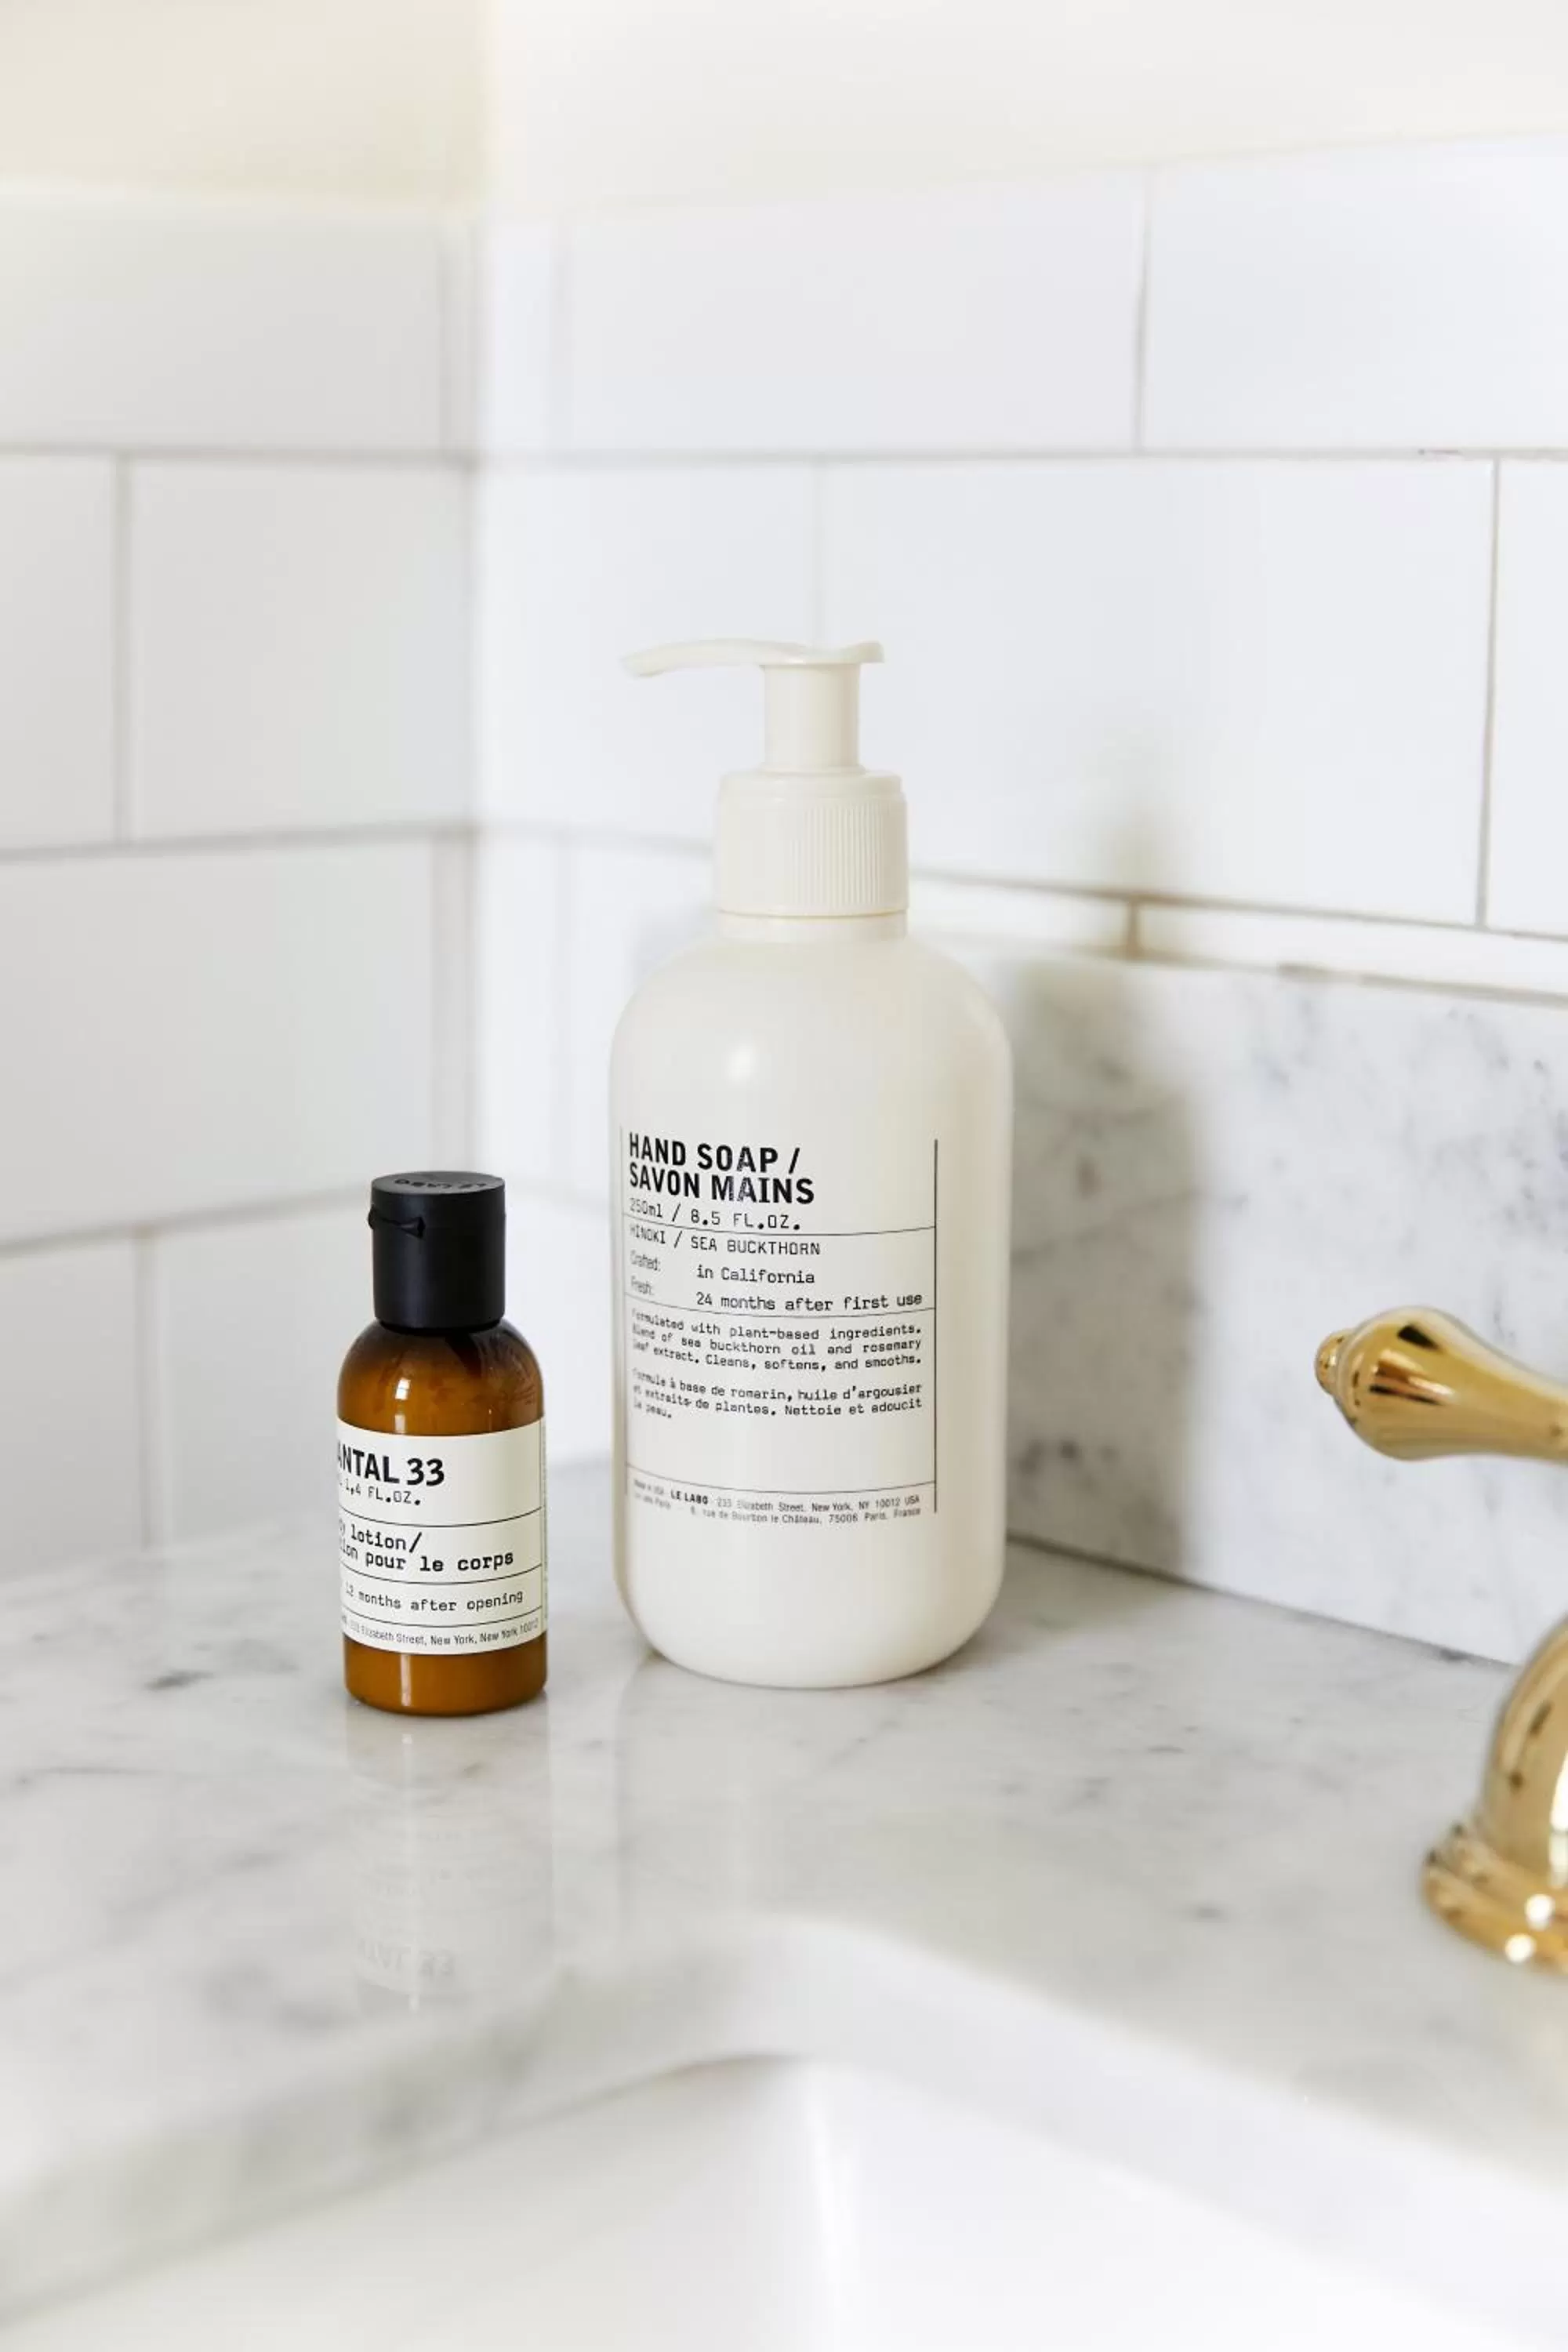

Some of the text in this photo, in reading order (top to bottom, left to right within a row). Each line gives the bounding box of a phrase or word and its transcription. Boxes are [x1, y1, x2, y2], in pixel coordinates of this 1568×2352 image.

[630, 1132, 800, 1174] HAND SOAP /
[630, 1161, 814, 1204] SAVON MAINS
[630, 1197, 662, 1218] 250ml
[691, 1208, 720, 1225] 8.5
[733, 1213, 800, 1230] FL.OZ.
[630, 1224, 666, 1244] HINOKI
[691, 1236, 717, 1251] SEA
[727, 1239, 821, 1255] BUCKTHORN
[697, 1264, 714, 1279] in
[720, 1266, 815, 1284] California
[696, 1291, 713, 1305] 24
[720, 1296, 775, 1310] months
[785, 1298, 833, 1312] after
[844, 1295, 889, 1310] first
[896, 1294, 923, 1307] use
[691, 1322, 720, 1335] with
[730, 1326, 819, 1341] plant-based
[830, 1324, 921, 1341] ingredients.
[662, 1332, 673, 1343] of
[681, 1337, 702, 1348] sea
[710, 1338, 781, 1354] buckthorn
[791, 1343, 816, 1356] oil
[827, 1344, 852, 1355] and
[863, 1339, 921, 1353] rosemary
[653, 1347, 699, 1364] extract.
[706, 1354, 757, 1370] Cleans,
[764, 1359, 826, 1370] softens,
[834, 1359, 858, 1370] and
[865, 1354, 921, 1369] smooths.
[680, 1380, 706, 1394] base
[711, 1386, 726, 1396] de
[731, 1389, 793, 1403] romarin,
[798, 1389, 837, 1401] huile
[843, 1384, 922, 1399] d'argousier
[695, 1399, 710, 1410] de
[715, 1400, 776, 1416] plantes.
[785, 1405, 841, 1416] Nettoie
[849, 1404, 865, 1414] et
[871, 1398, 923, 1414] adoucit
[407, 1457, 445, 1486] 33
[368, 1486, 421, 1506] FL.OZ.
[670, 1489, 681, 1501] LE
[684, 1492, 709, 1505] LABO
[811, 1502, 829, 1512] New
[858, 1501, 869, 1511] NY
[904, 1494, 920, 1506] USA
[351, 1523, 423, 1553] lotion/
[366, 1552, 406, 1570] pour
[419, 1555, 444, 1572] le
[457, 1552, 514, 1570] corps
[358, 1590, 402, 1610] months
[410, 1599, 457, 1611] after
[466, 1591, 523, 1612] opening
[431, 1635, 451, 1646] New
[454, 1634, 477, 1645] York,
[480, 1632, 499, 1642] New
[501, 1628, 517, 1639] York
